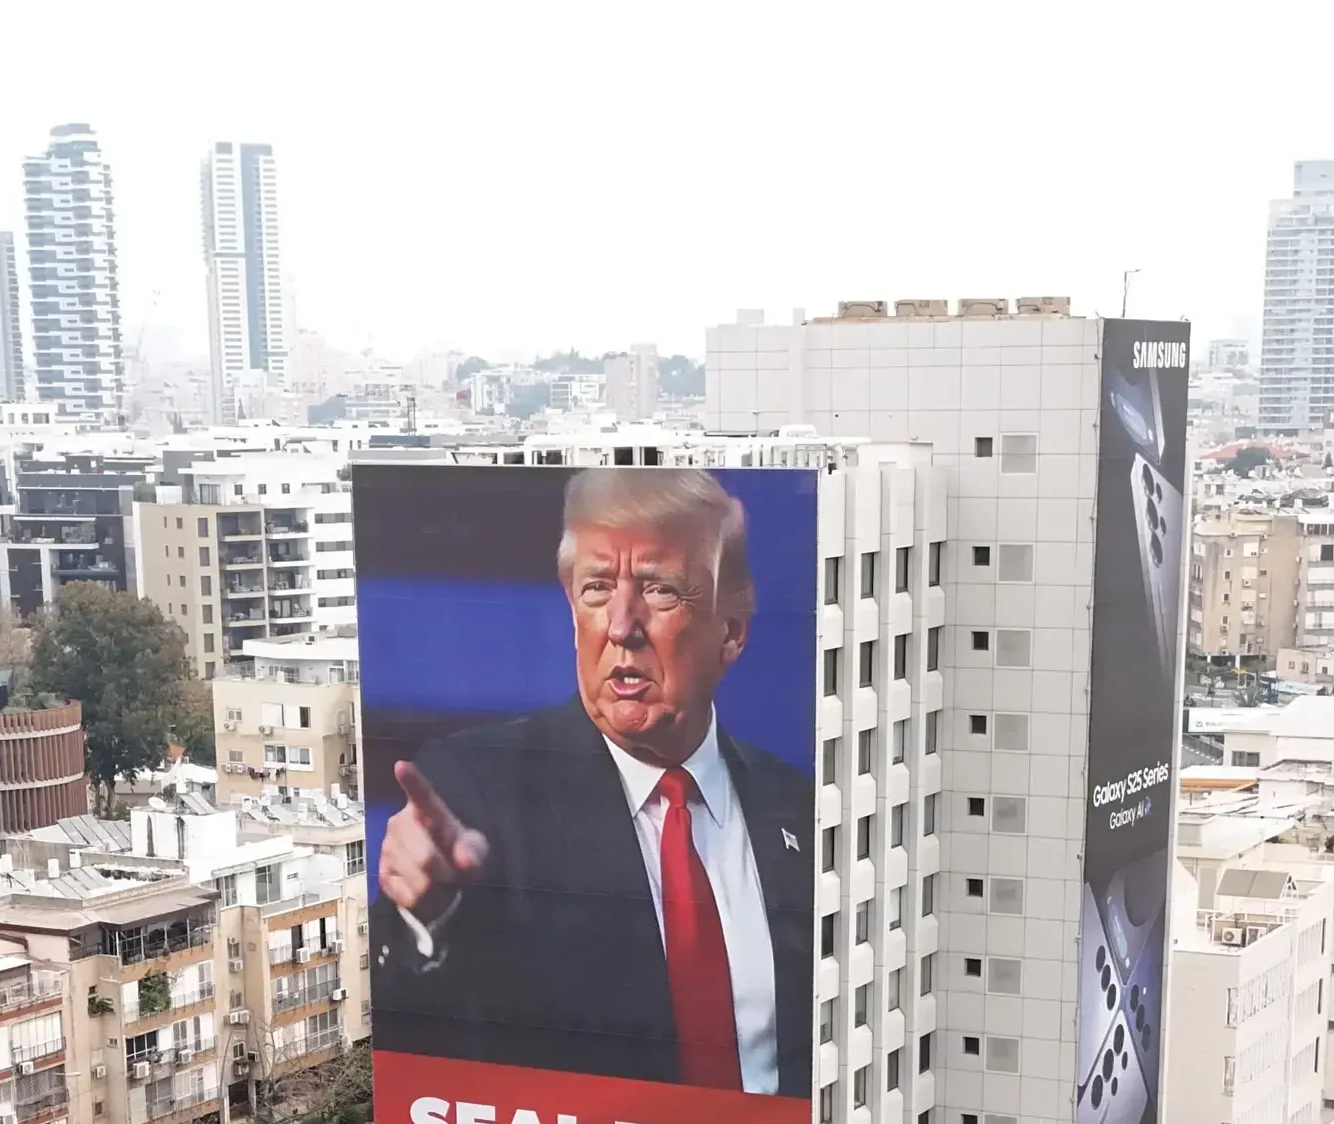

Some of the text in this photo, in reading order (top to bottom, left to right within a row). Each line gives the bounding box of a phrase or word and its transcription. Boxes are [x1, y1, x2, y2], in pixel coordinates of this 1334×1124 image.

[1133, 341, 1186, 369] SAMSUNG
[1093, 761, 1169, 808] Galaxy S25 Series
[1109, 806, 1136, 830] Galaxy
